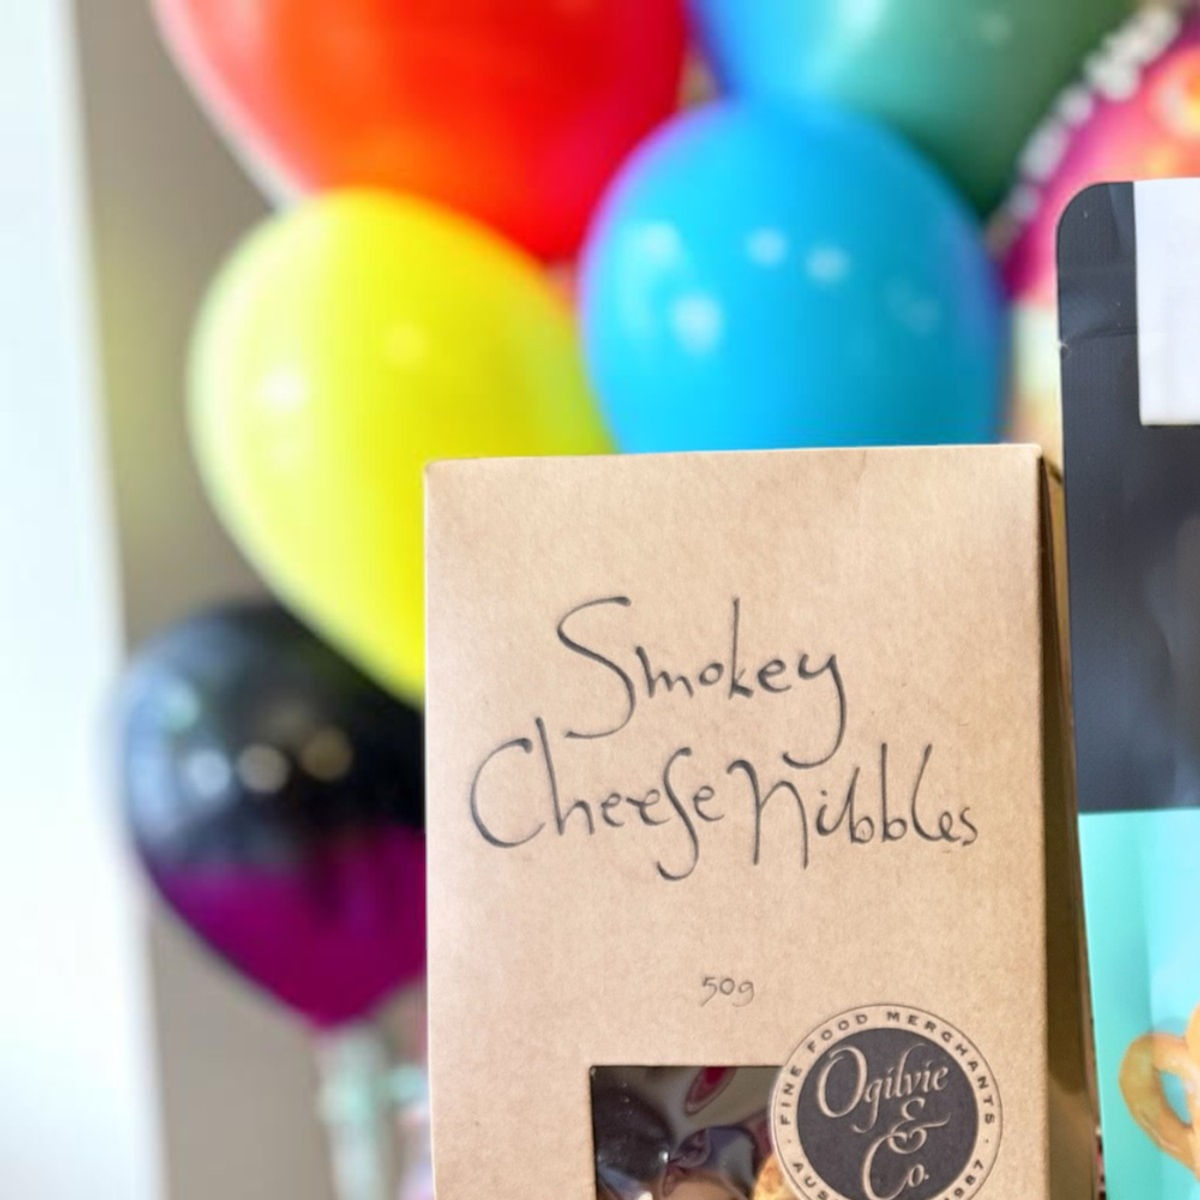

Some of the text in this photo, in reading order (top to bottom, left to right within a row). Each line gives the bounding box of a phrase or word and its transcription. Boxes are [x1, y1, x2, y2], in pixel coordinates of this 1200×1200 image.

[556, 596, 847, 768] Smokey
[469, 716, 978, 880] Cheese Nibbles
[700, 975, 756, 1007] 50g
[780, 1010, 996, 1126] FINE FOOD MERCHANTS
[817, 1042, 949, 1133] Ogilvie
[889, 1096, 951, 1154] &
